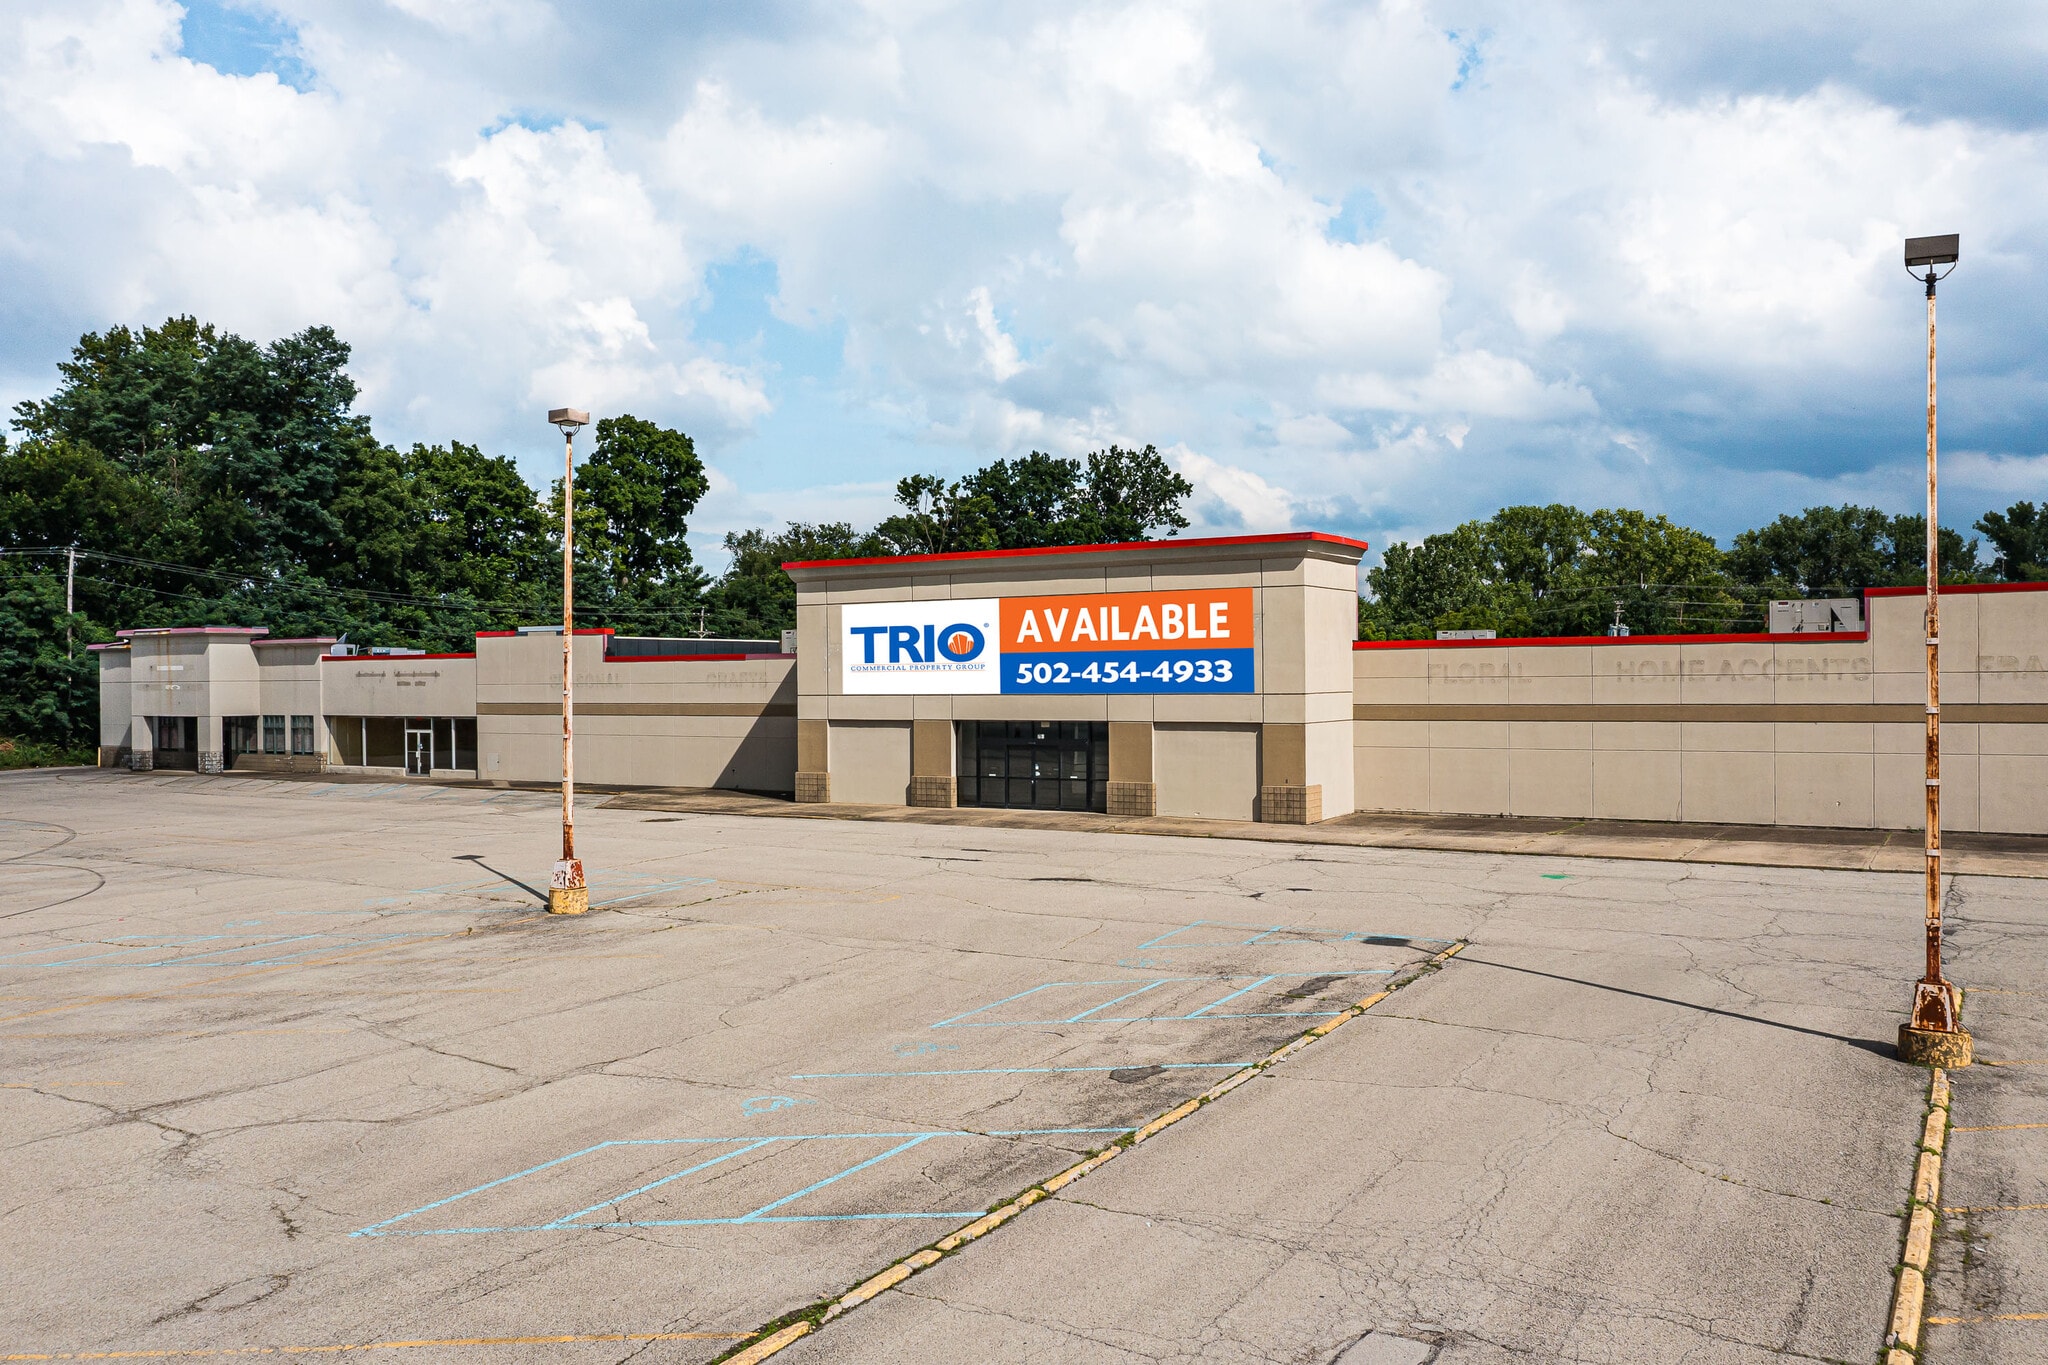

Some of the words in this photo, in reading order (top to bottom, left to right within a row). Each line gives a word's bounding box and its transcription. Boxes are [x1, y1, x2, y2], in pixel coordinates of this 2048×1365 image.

[1016, 601, 1231, 643] AVAILABLE
[850, 623, 985, 663] TRIO
[850, 664, 906, 672] COMMERCIAL
[1016, 659, 1233, 685] 502-454-4933
[1428, 662, 1533, 685] FLORAL
[1616, 659, 1706, 683] HOME
[1715, 657, 1871, 682] ACCENTS
